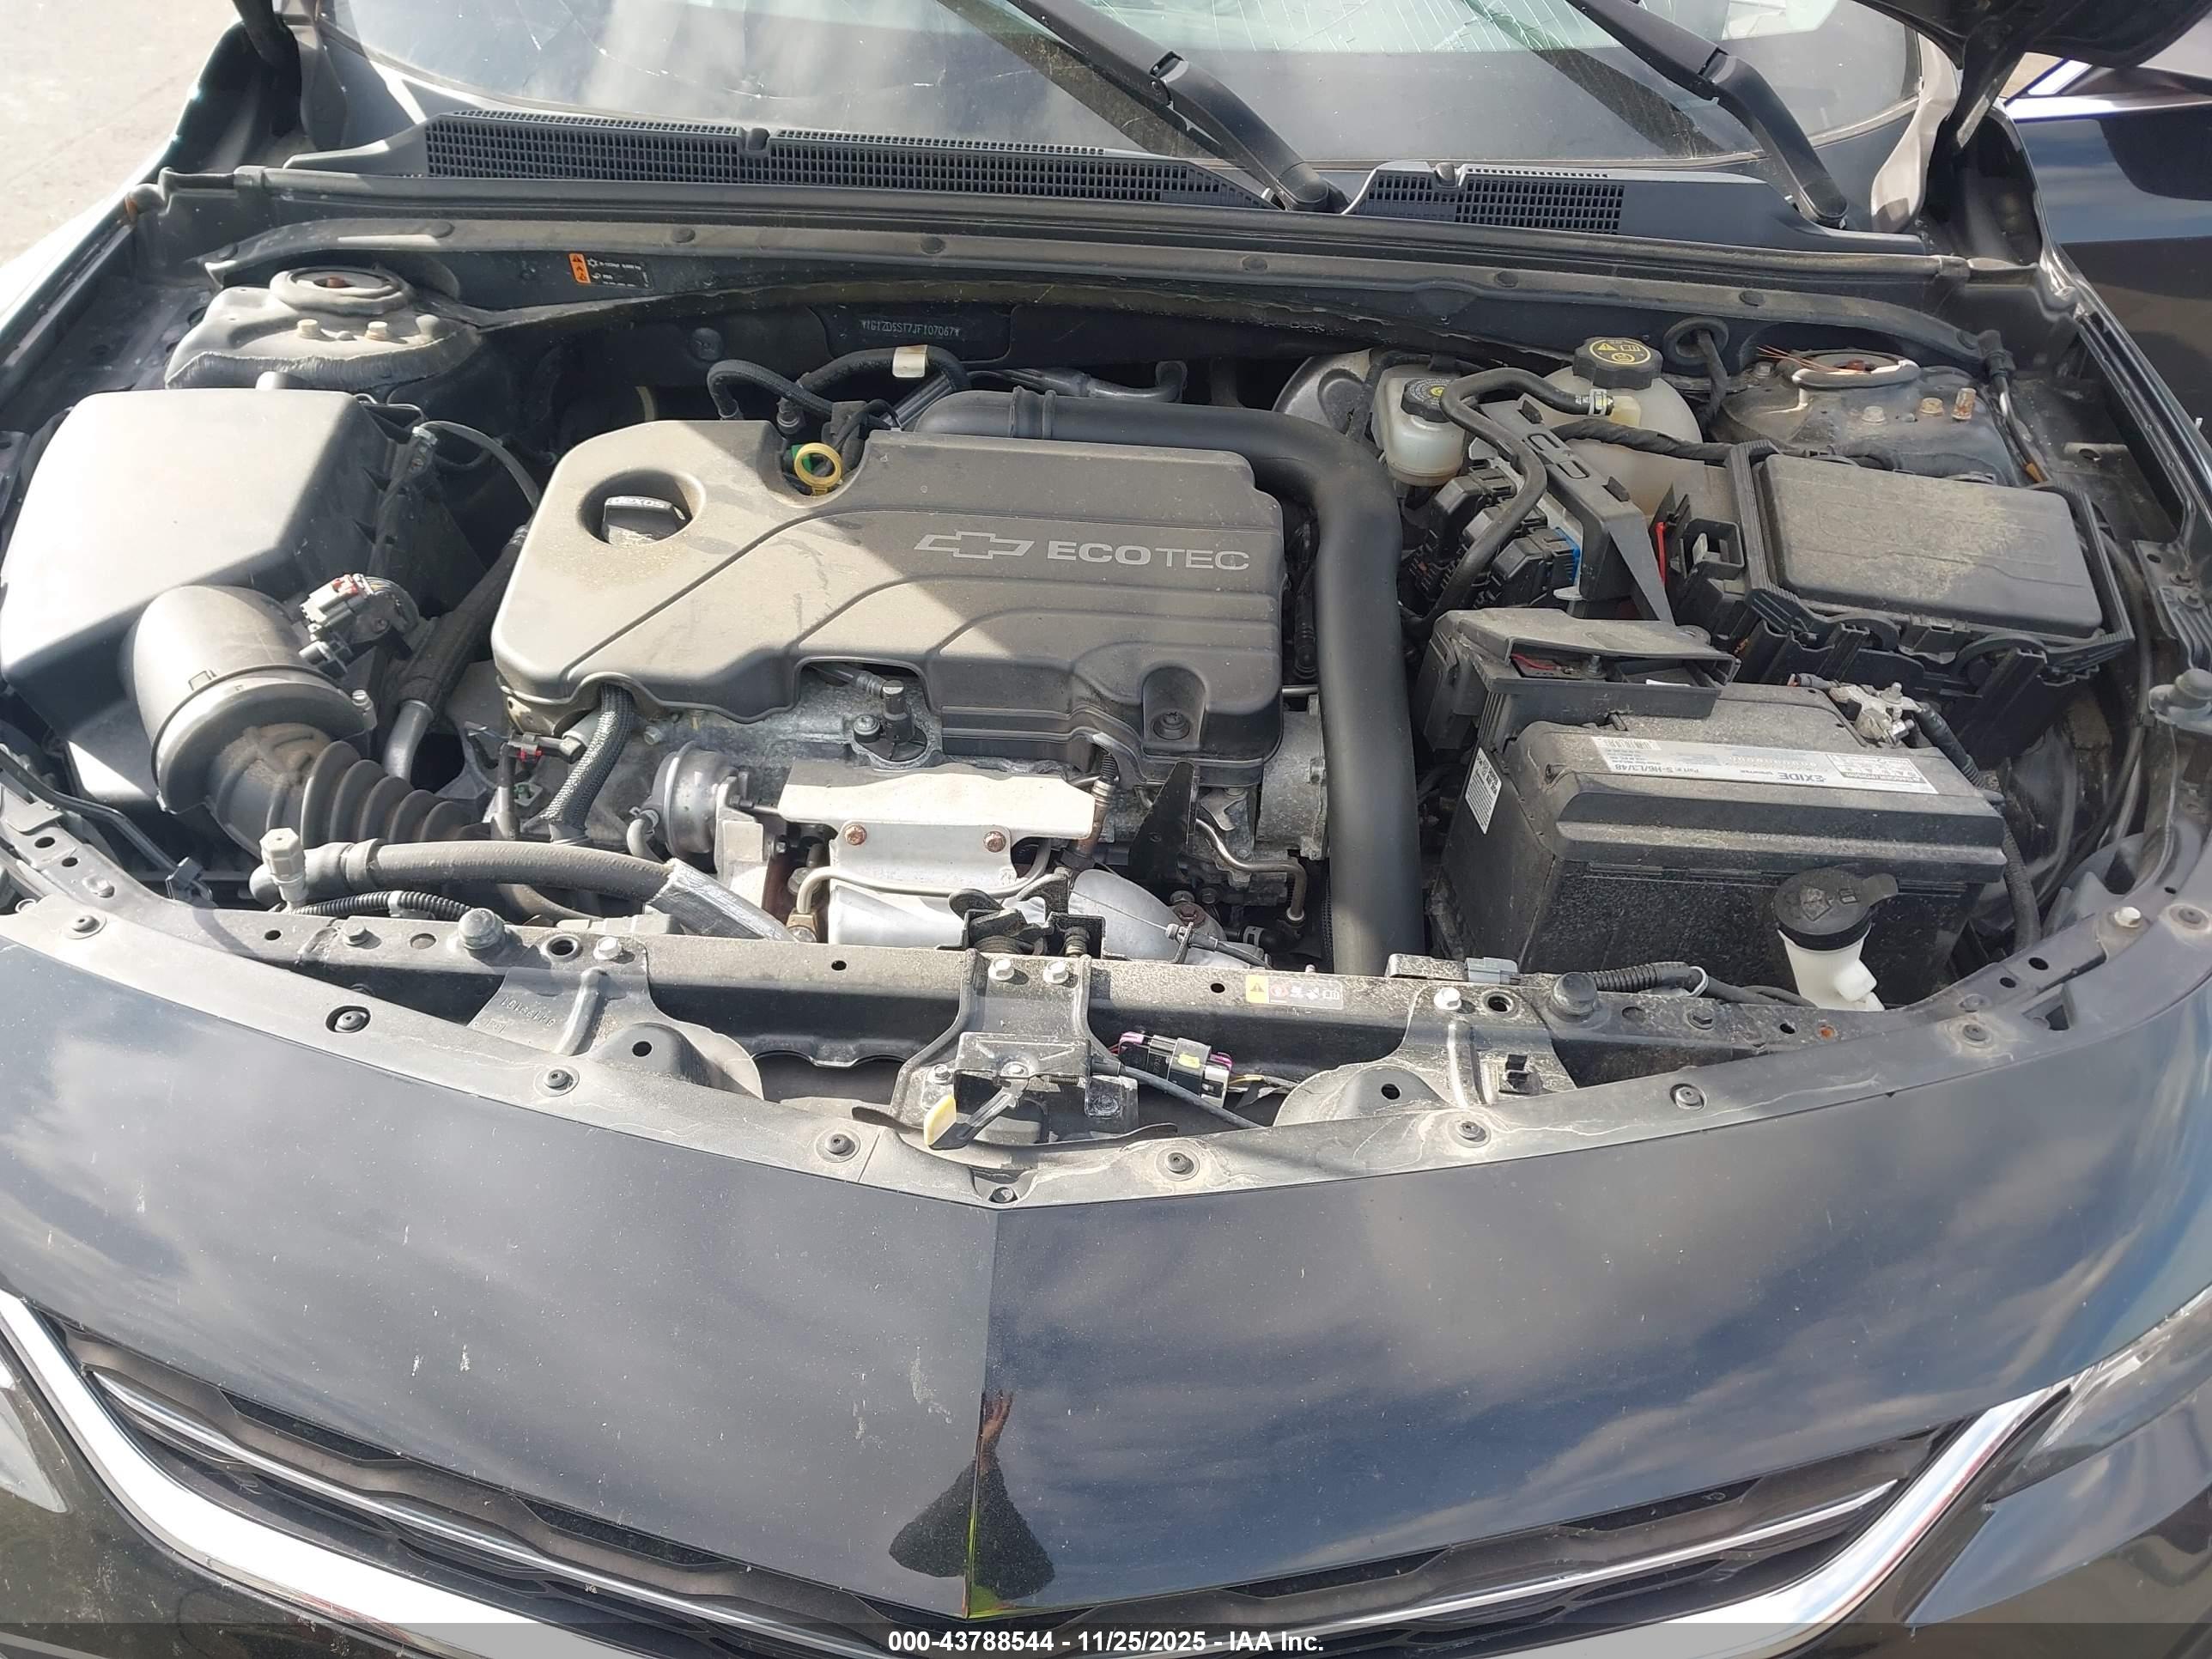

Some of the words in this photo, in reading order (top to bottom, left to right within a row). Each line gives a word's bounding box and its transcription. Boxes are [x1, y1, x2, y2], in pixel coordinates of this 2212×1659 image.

[611, 495, 665, 508] dexos
[1047, 539, 1250, 571] ECOTEC
[1778, 772, 1826, 782] EXIDE
